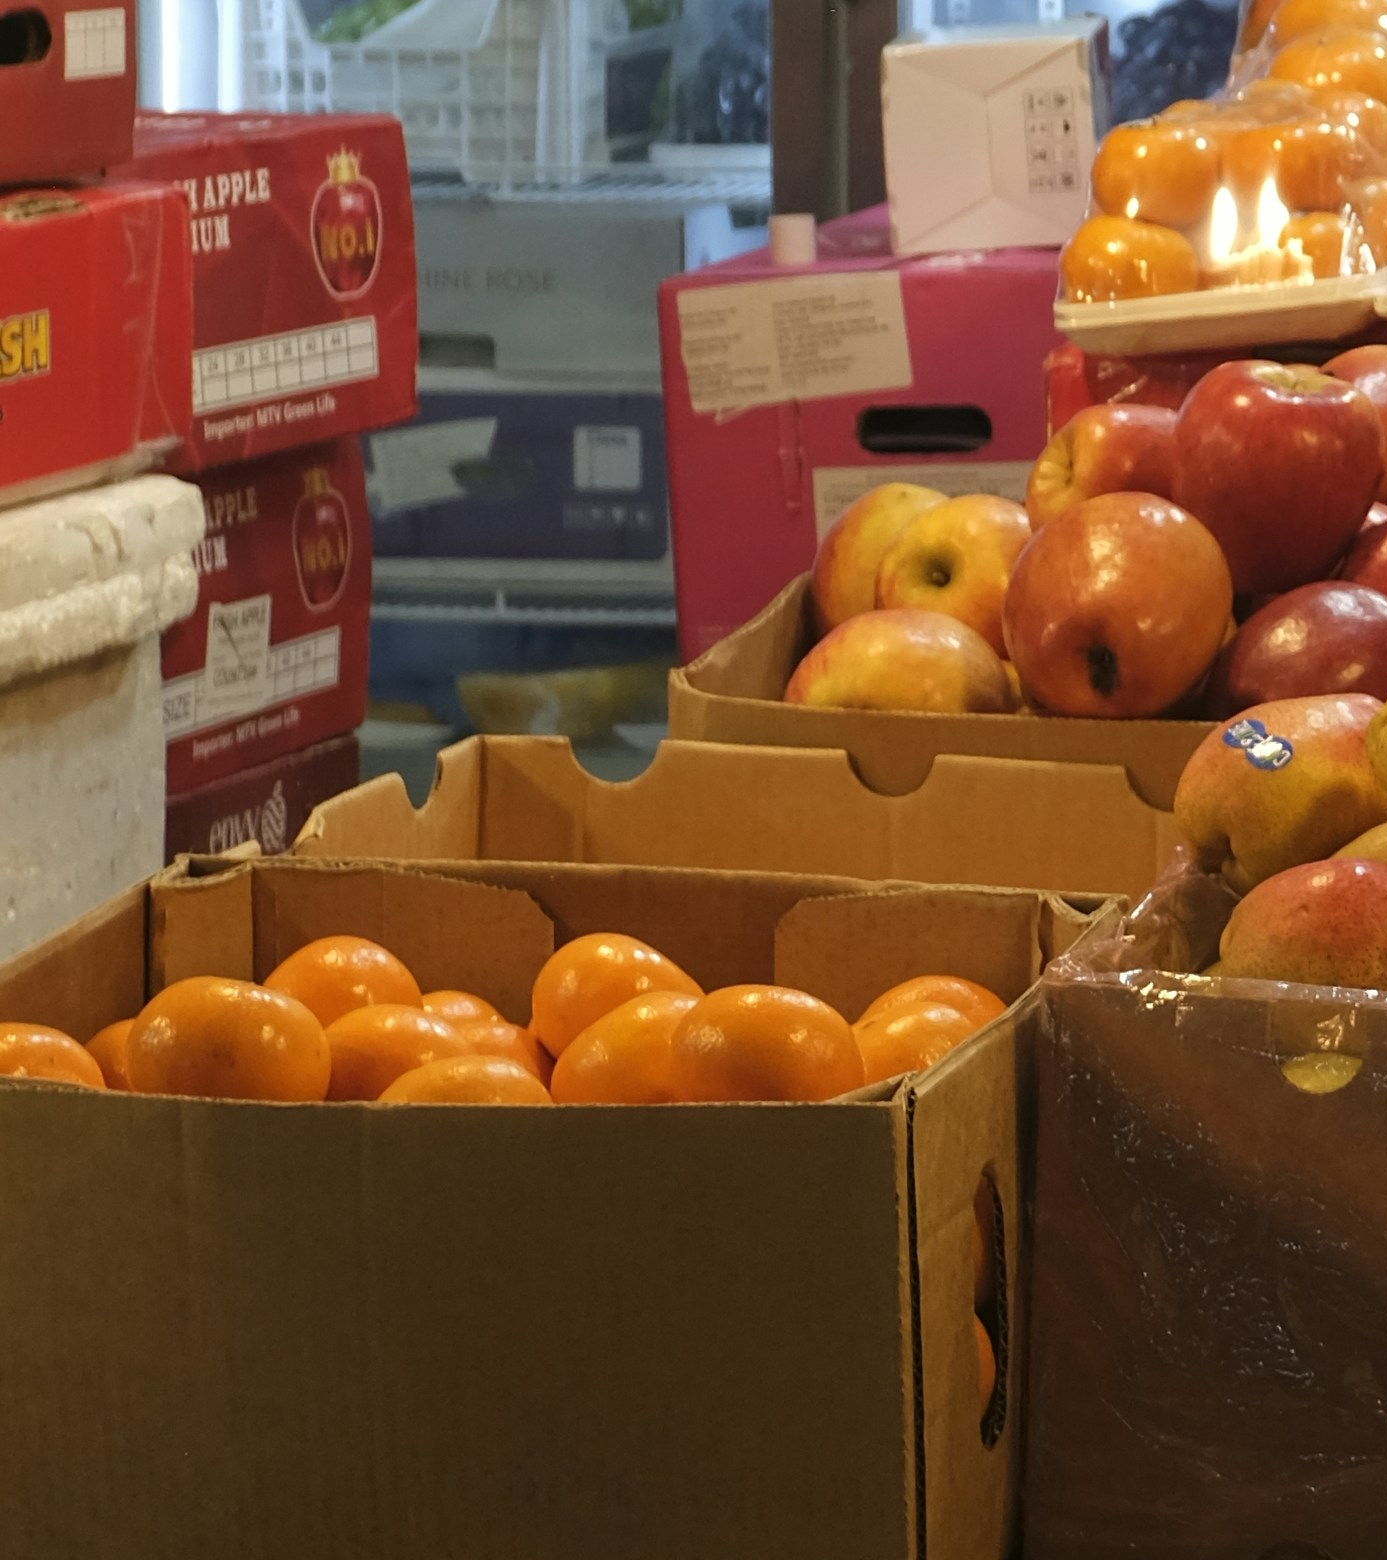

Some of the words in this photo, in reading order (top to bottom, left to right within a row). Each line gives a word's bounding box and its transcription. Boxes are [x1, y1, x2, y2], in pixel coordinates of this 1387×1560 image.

[202, 167, 271, 209] APPLE
[189, 214, 231, 254] IUM
[256, 401, 281, 429] MTV
[283, 397, 315, 419] Green
[316, 392, 336, 412] Life
[205, 486, 258, 530] APPLE
[163, 693, 192, 725] SIZE
[209, 805, 261, 855] envy
